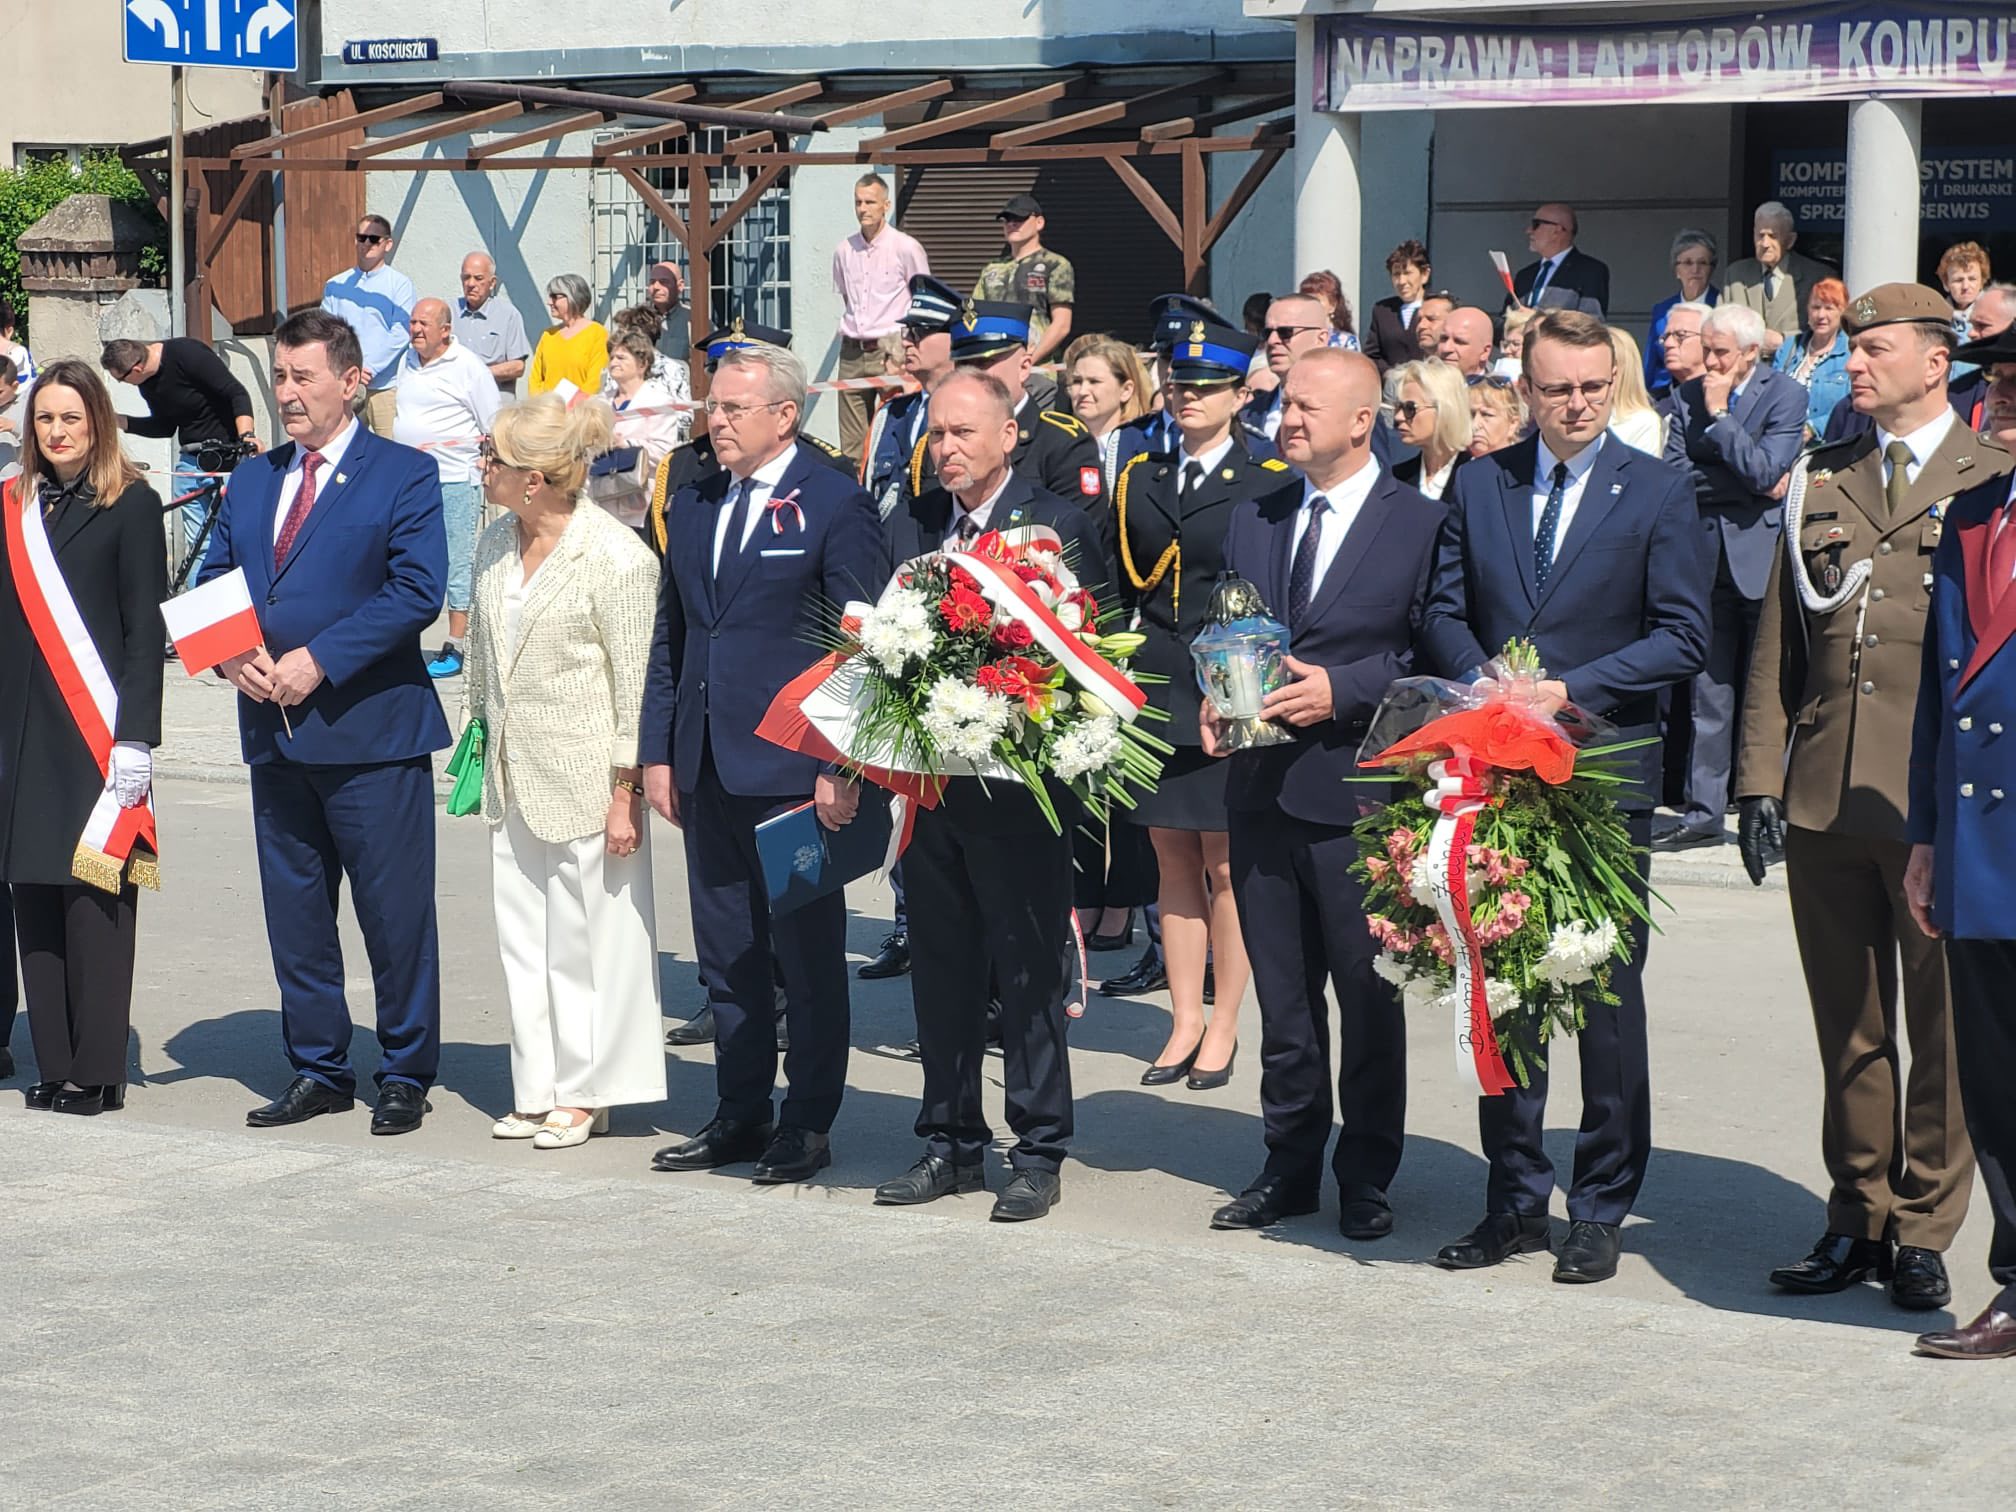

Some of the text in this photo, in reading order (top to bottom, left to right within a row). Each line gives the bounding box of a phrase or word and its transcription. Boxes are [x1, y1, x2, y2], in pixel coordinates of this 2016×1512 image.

[368, 41, 428, 59] KOŚCIUSZKI
[1838, 17, 2016, 80] KOMPU
[1920, 159, 2013, 180] SYSTEM
[1943, 183, 2012, 196] DRUKARKI
